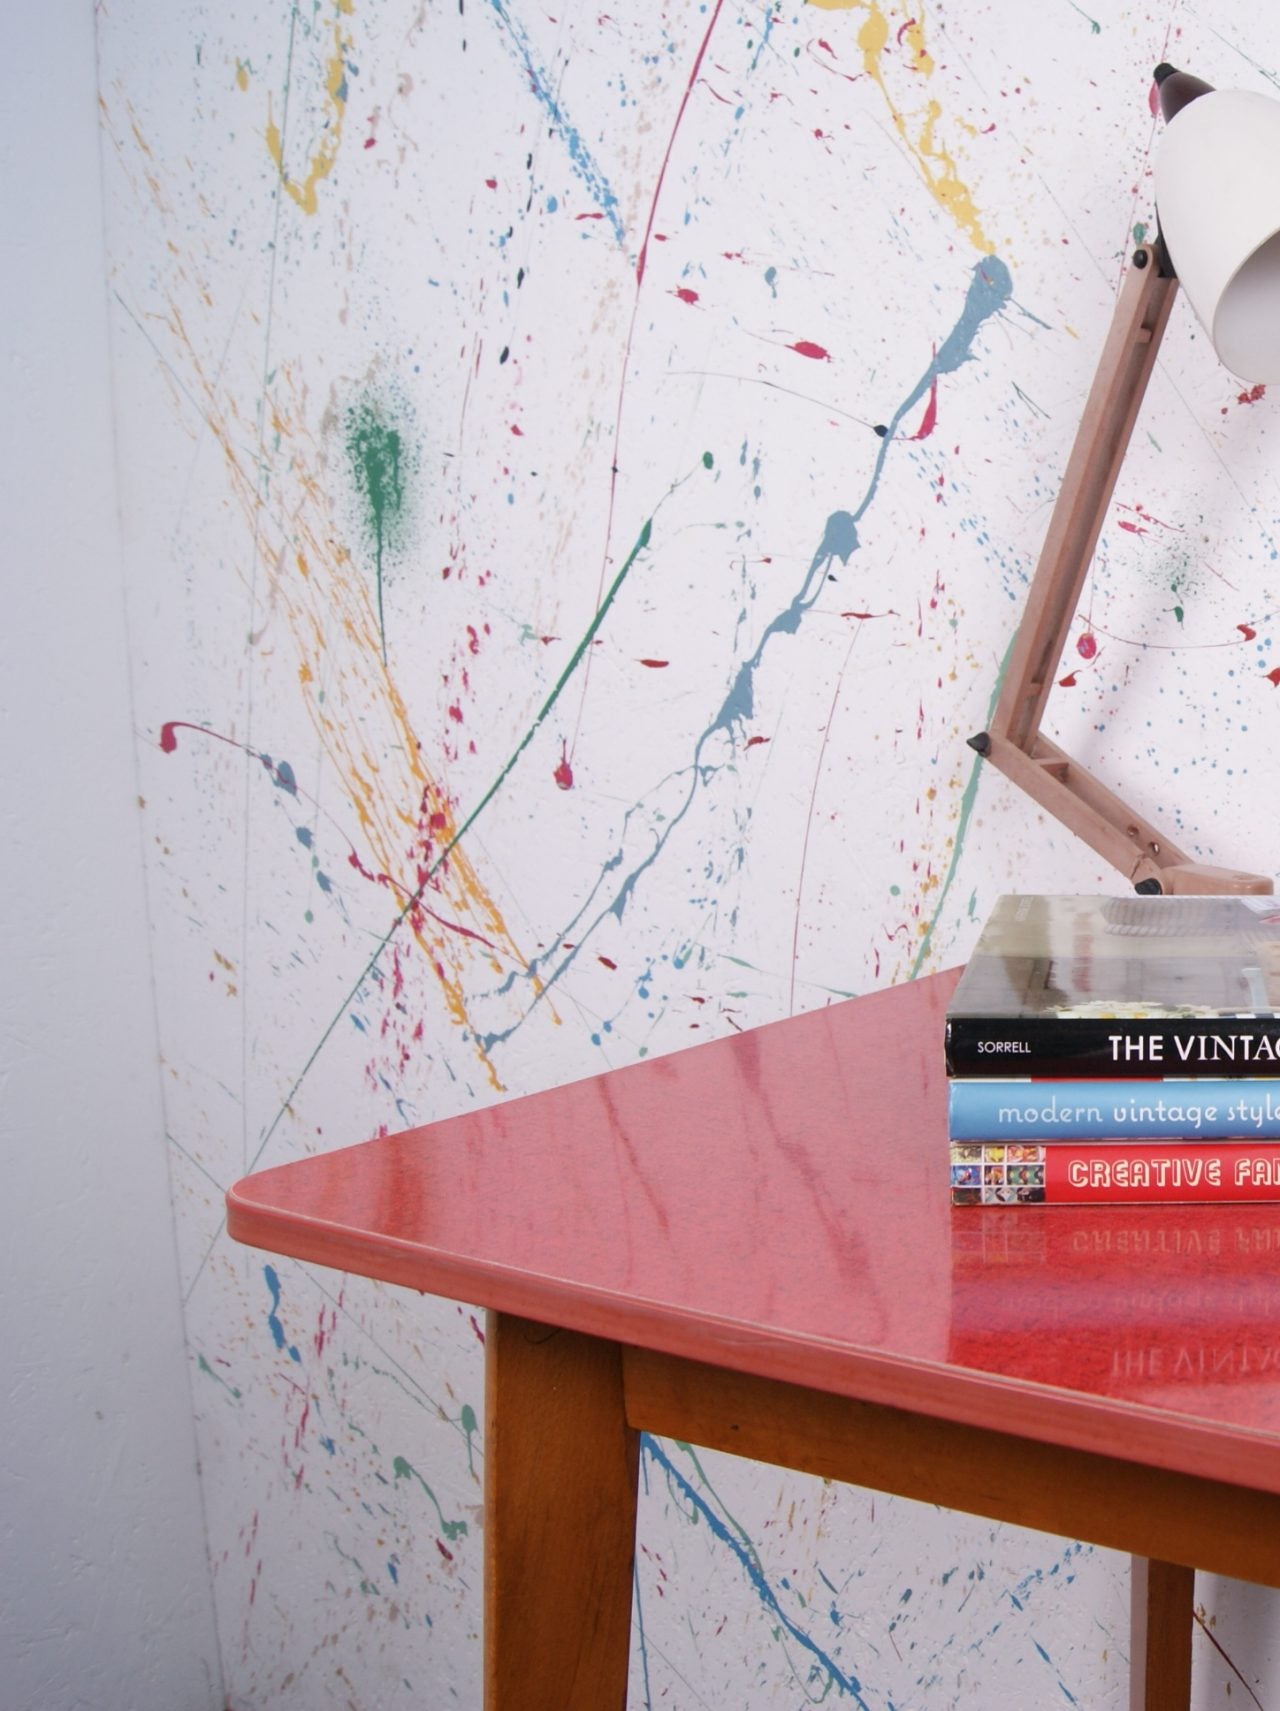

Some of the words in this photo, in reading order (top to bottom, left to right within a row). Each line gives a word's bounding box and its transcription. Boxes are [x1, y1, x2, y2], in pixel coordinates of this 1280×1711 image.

[977, 1041, 1032, 1054] SORRELL
[1108, 1035, 1164, 1061] THE
[998, 1095, 1103, 1124] modern
[1112, 1097, 1217, 1129] vintage
[1067, 1158, 1222, 1188] CREATIVE
